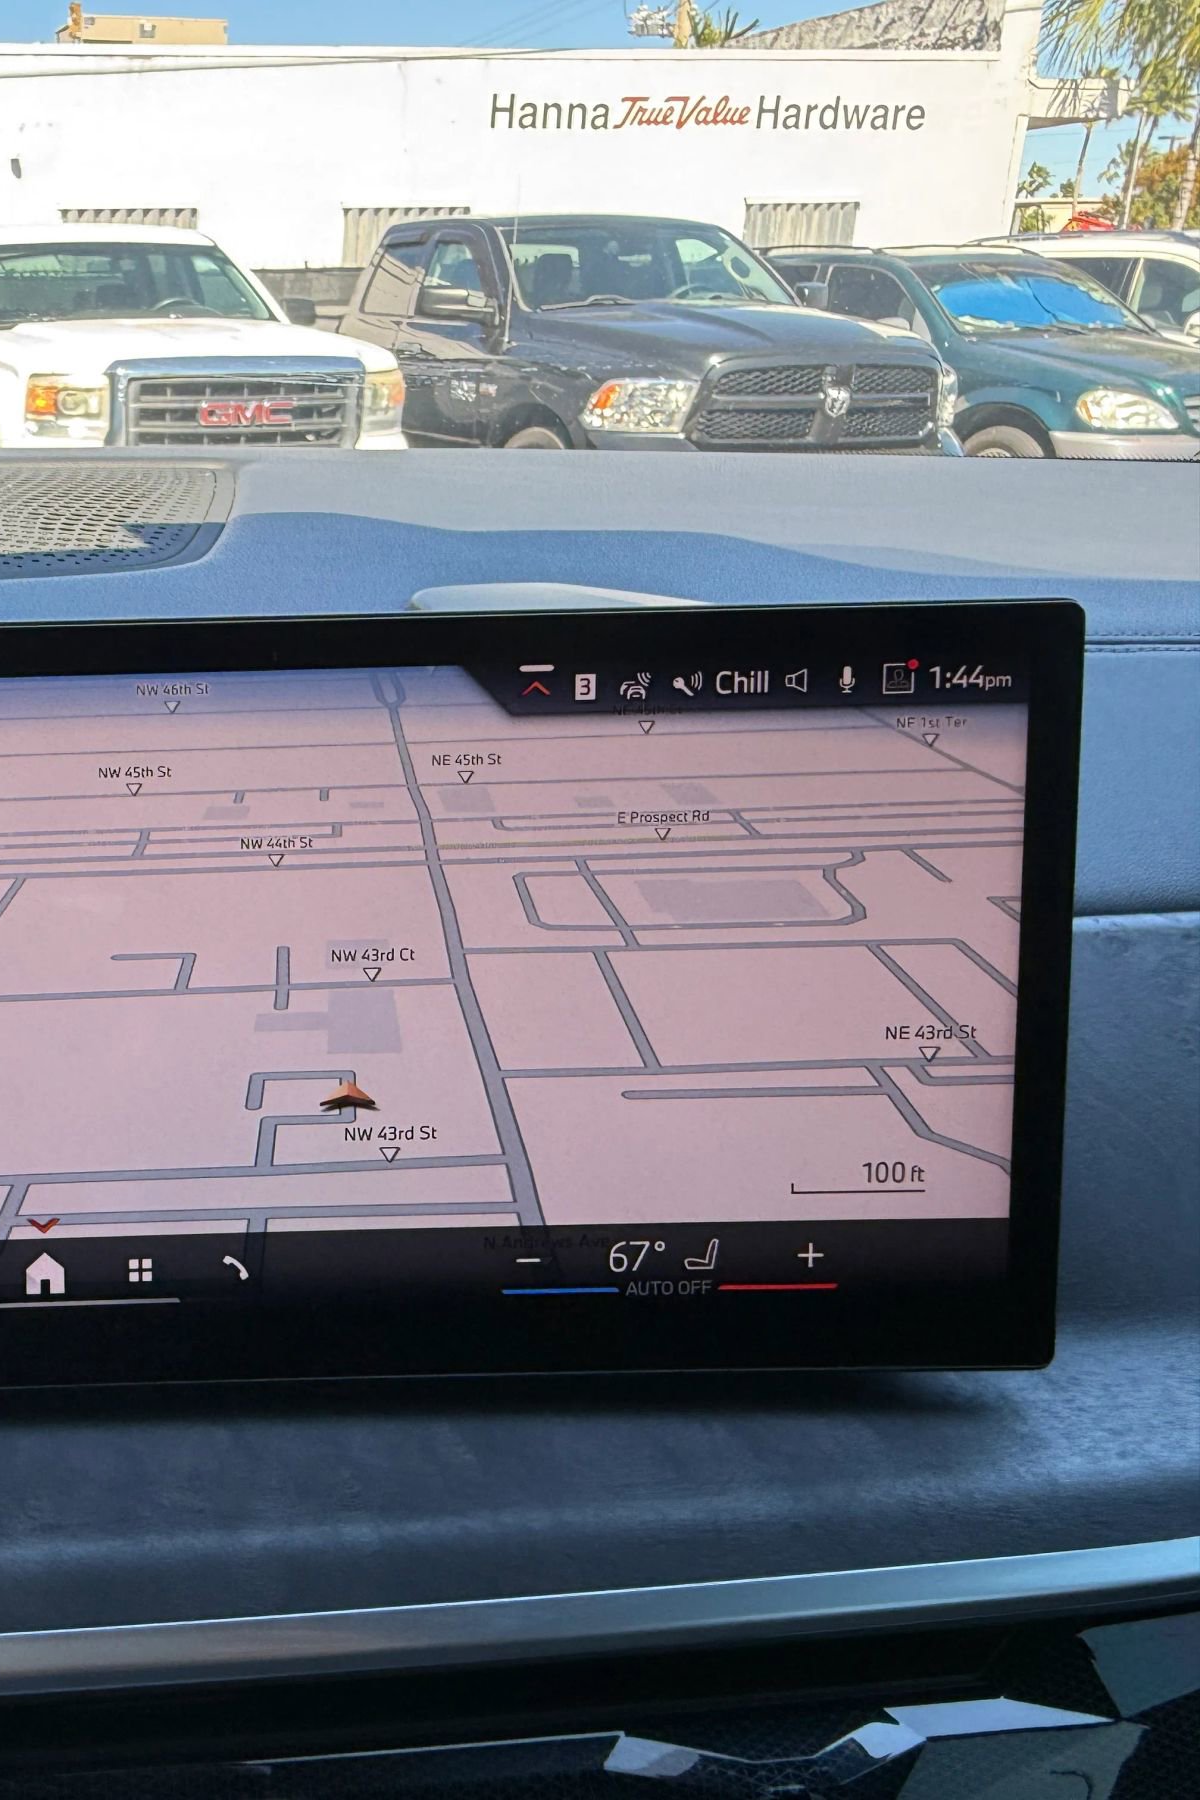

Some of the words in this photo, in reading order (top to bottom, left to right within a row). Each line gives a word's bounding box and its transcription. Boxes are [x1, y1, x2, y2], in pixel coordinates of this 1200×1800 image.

[490, 93, 610, 130] Hanna
[756, 95, 926, 131] Hardware
[199, 399, 295, 427] GMC
[716, 671, 769, 696] Chill
[929, 667, 1012, 692] 1:44pm
[136, 684, 158, 695] NW
[163, 683, 192, 695] 46th
[196, 682, 209, 694] St
[921, 716, 940, 728] 1st
[945, 716, 967, 727] Ter
[432, 754, 451, 766] NE
[455, 754, 483, 765] 45th
[487, 753, 502, 765] St
[98, 767, 121, 778] NW
[126, 766, 153, 778] 45th
[158, 765, 171, 777] St
[617, 812, 625, 824] E
[630, 810, 687, 826] Prospect
[692, 810, 710, 823] Rd
[240, 838, 263, 849] NW
[267, 837, 295, 849] 44th
[300, 836, 313, 848] St
[331, 949, 357, 963] NW
[361, 947, 394, 962] 43rd
[399, 946, 415, 961] Ct
[886, 1026, 910, 1039] NE
[914, 1025, 953, 1040] 43rd
[958, 1024, 976, 1039] St
[344, 1127, 372, 1142] NW
[377, 1126, 415, 1141] 43rd
[420, 1125, 437, 1140] St
[862, 1160, 906, 1185] 100
[910, 1164, 925, 1184] ft
[625, 1279, 673, 1297] AUTO
[675, 1278, 713, 1296] OFF
